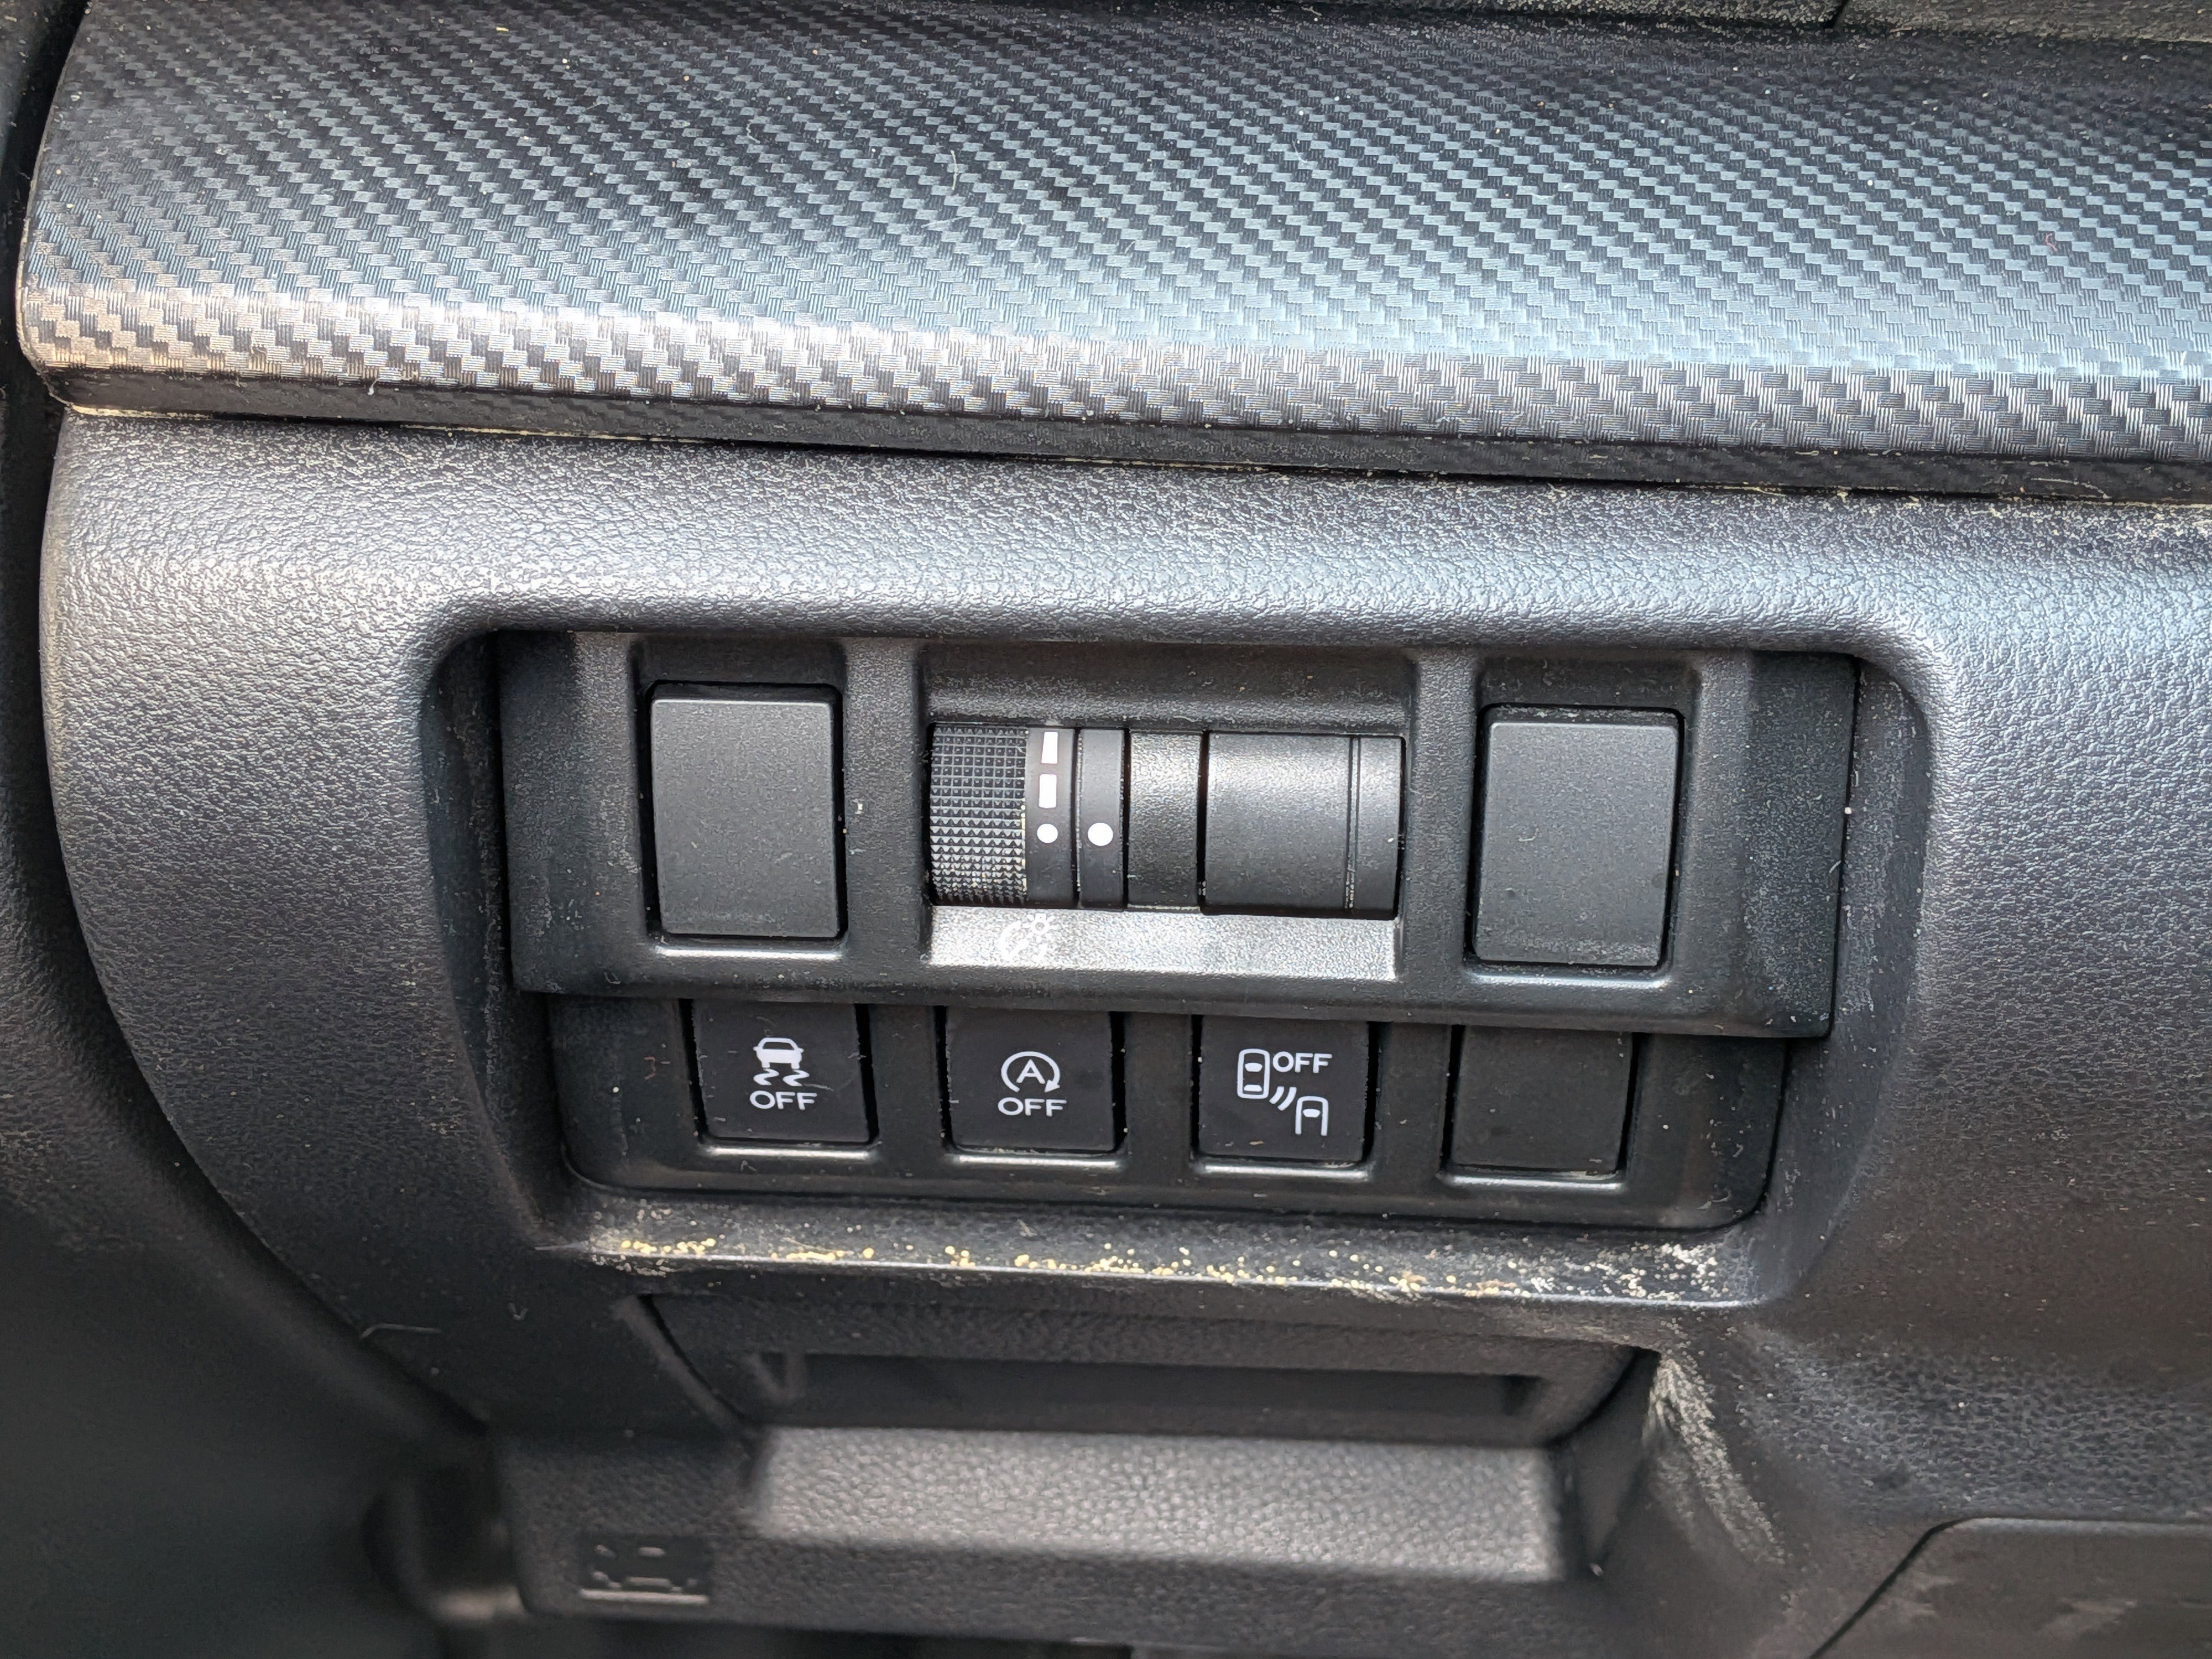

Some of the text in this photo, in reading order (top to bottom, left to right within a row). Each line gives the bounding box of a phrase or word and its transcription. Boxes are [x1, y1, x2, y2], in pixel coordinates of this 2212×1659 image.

[1016, 1059, 1046, 1084] A
[1272, 1051, 1333, 1073] OFF
[749, 1090, 817, 1110] OFF
[998, 1097, 1067, 1117] OFF
